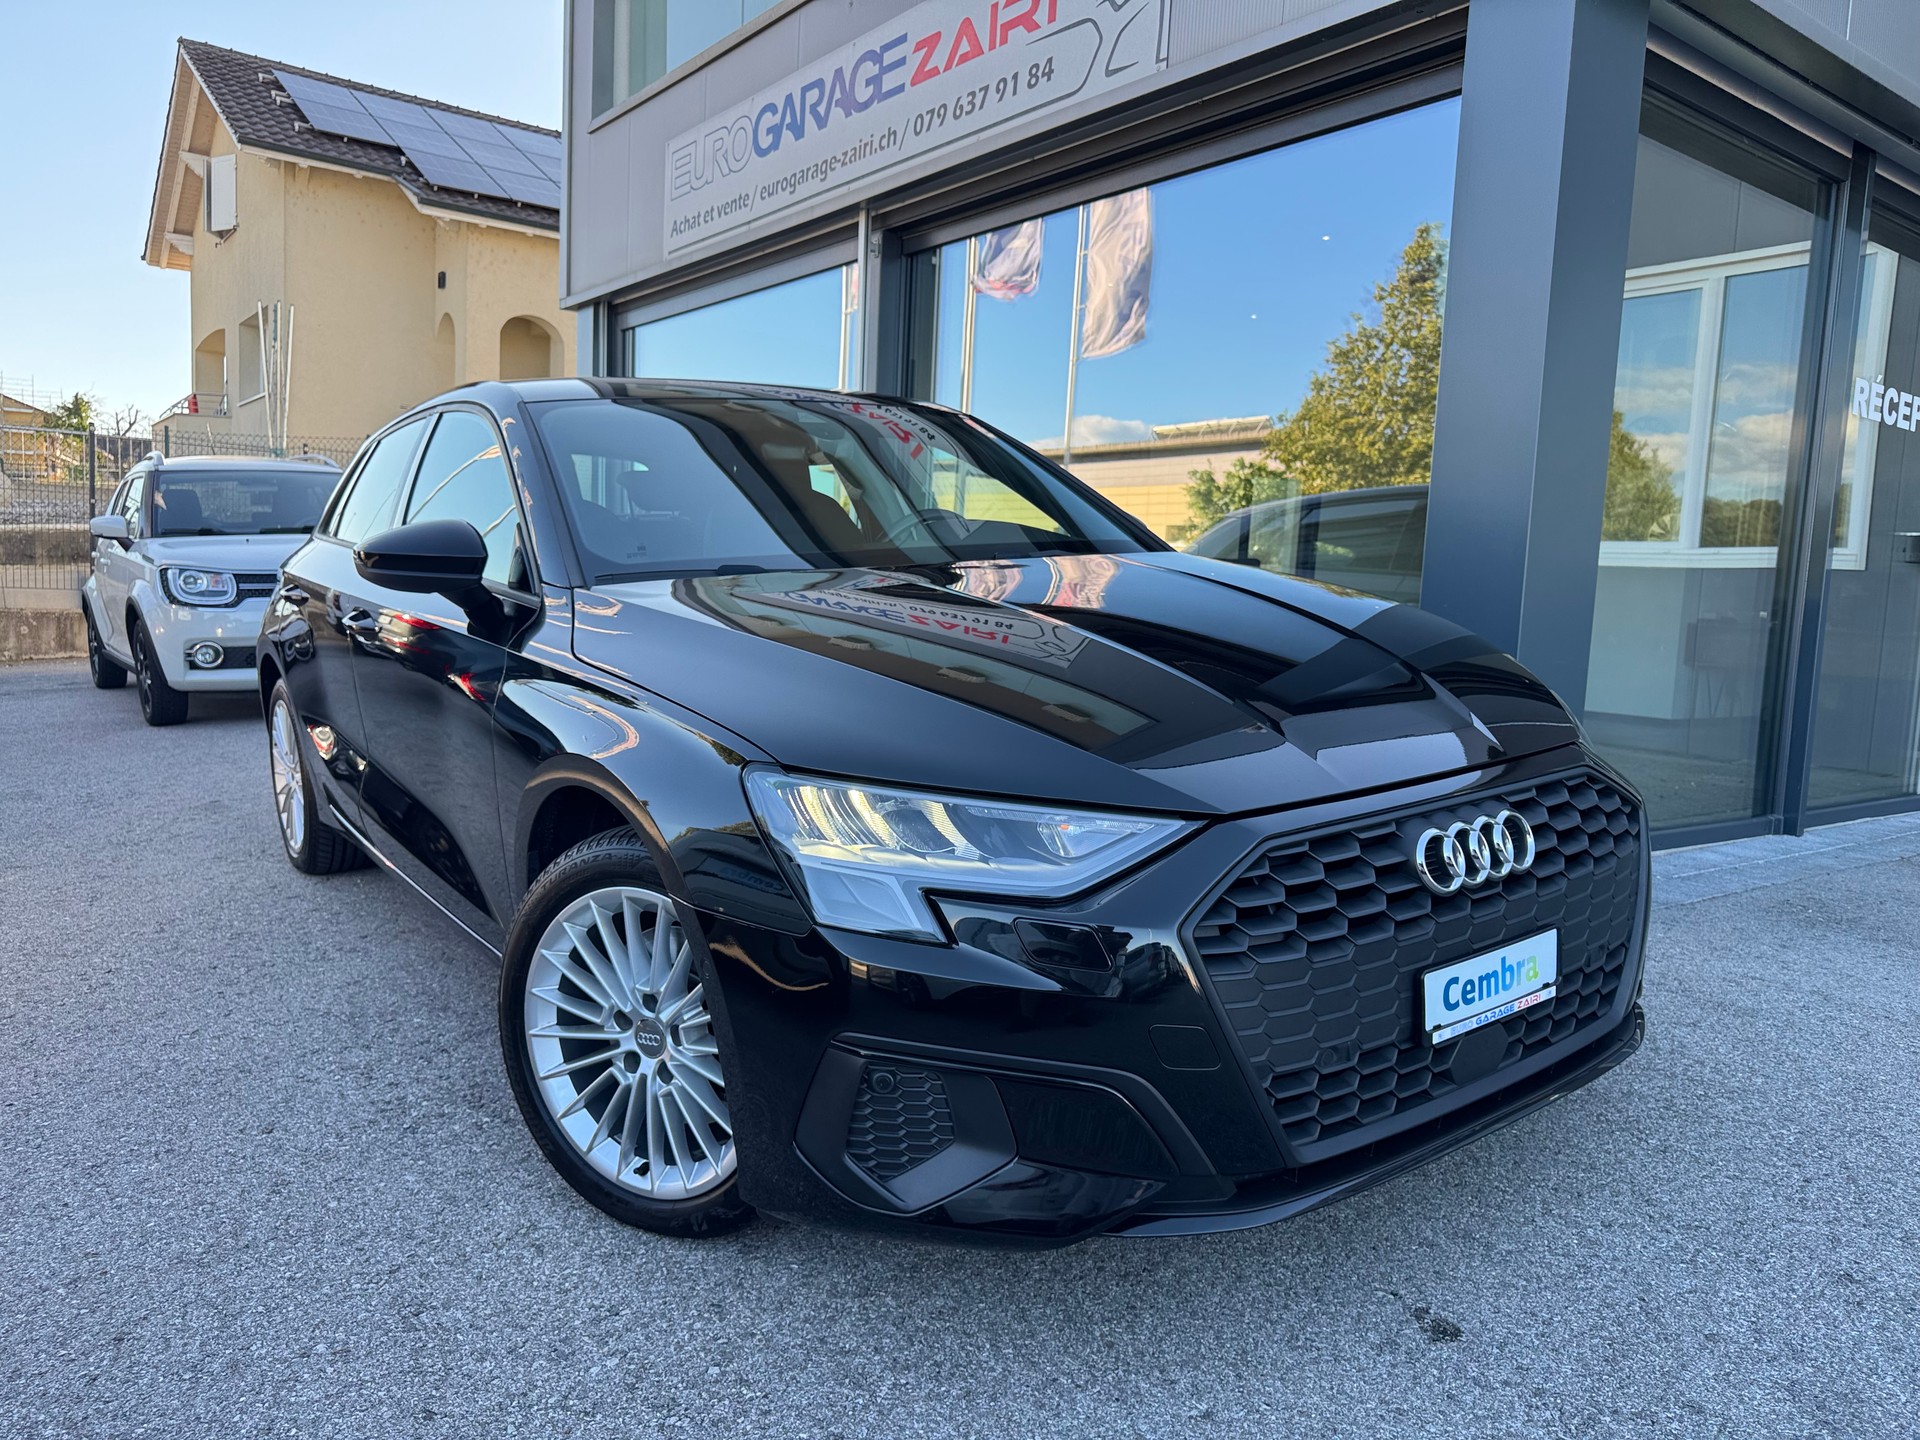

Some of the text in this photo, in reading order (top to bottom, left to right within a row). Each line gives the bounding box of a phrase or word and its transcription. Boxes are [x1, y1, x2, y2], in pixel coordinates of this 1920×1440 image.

[670, 211, 701, 238] Achat
[703, 204, 715, 224] et
[717, 192, 750, 219] vente
[760, 126, 897, 200] eurogarage-zairi.ch
[913, 103, 948, 137] 079
[952, 84, 990, 121] 637
[995, 71, 1019, 104] 91
[1027, 56, 1055, 90] 84
[541, 852, 613, 891] TURANZA
[1442, 955, 1540, 1012] Cembra
[1475, 1003, 1515, 1026] GARAGE
[1517, 993, 1541, 1010] ZAIRI
